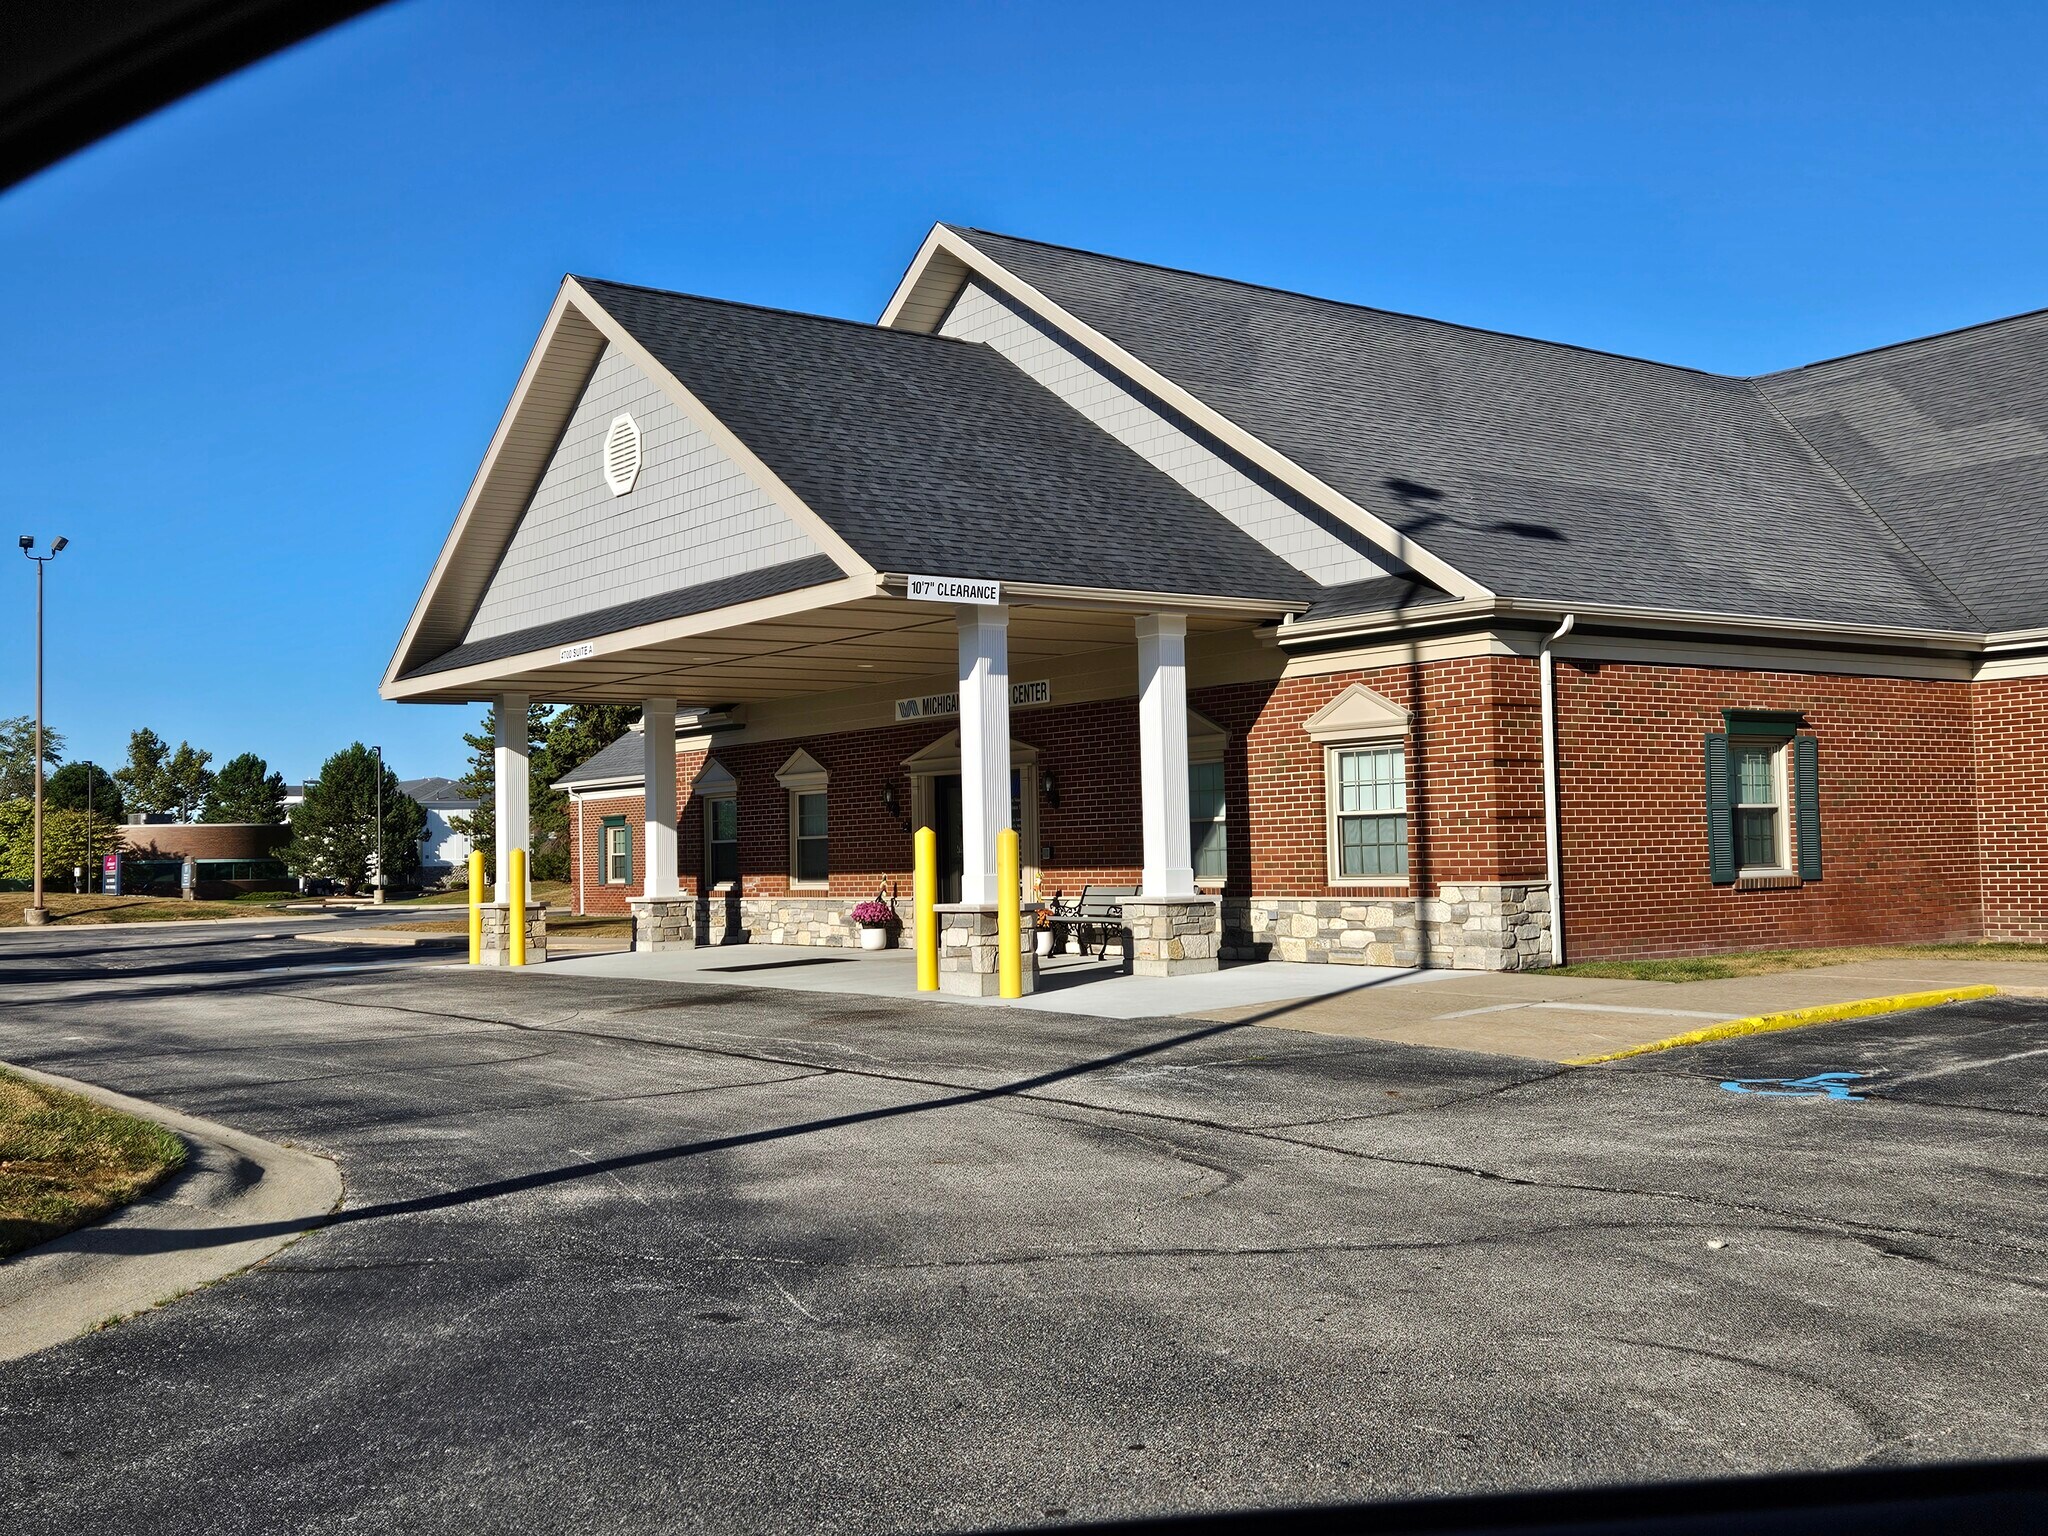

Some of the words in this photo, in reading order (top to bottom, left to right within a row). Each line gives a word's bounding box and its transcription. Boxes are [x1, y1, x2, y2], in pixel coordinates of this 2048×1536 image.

[937, 582, 996, 599] CLEARANCE
[573, 645, 588, 657] SUITE
[1012, 681, 1047, 704] CENTER
